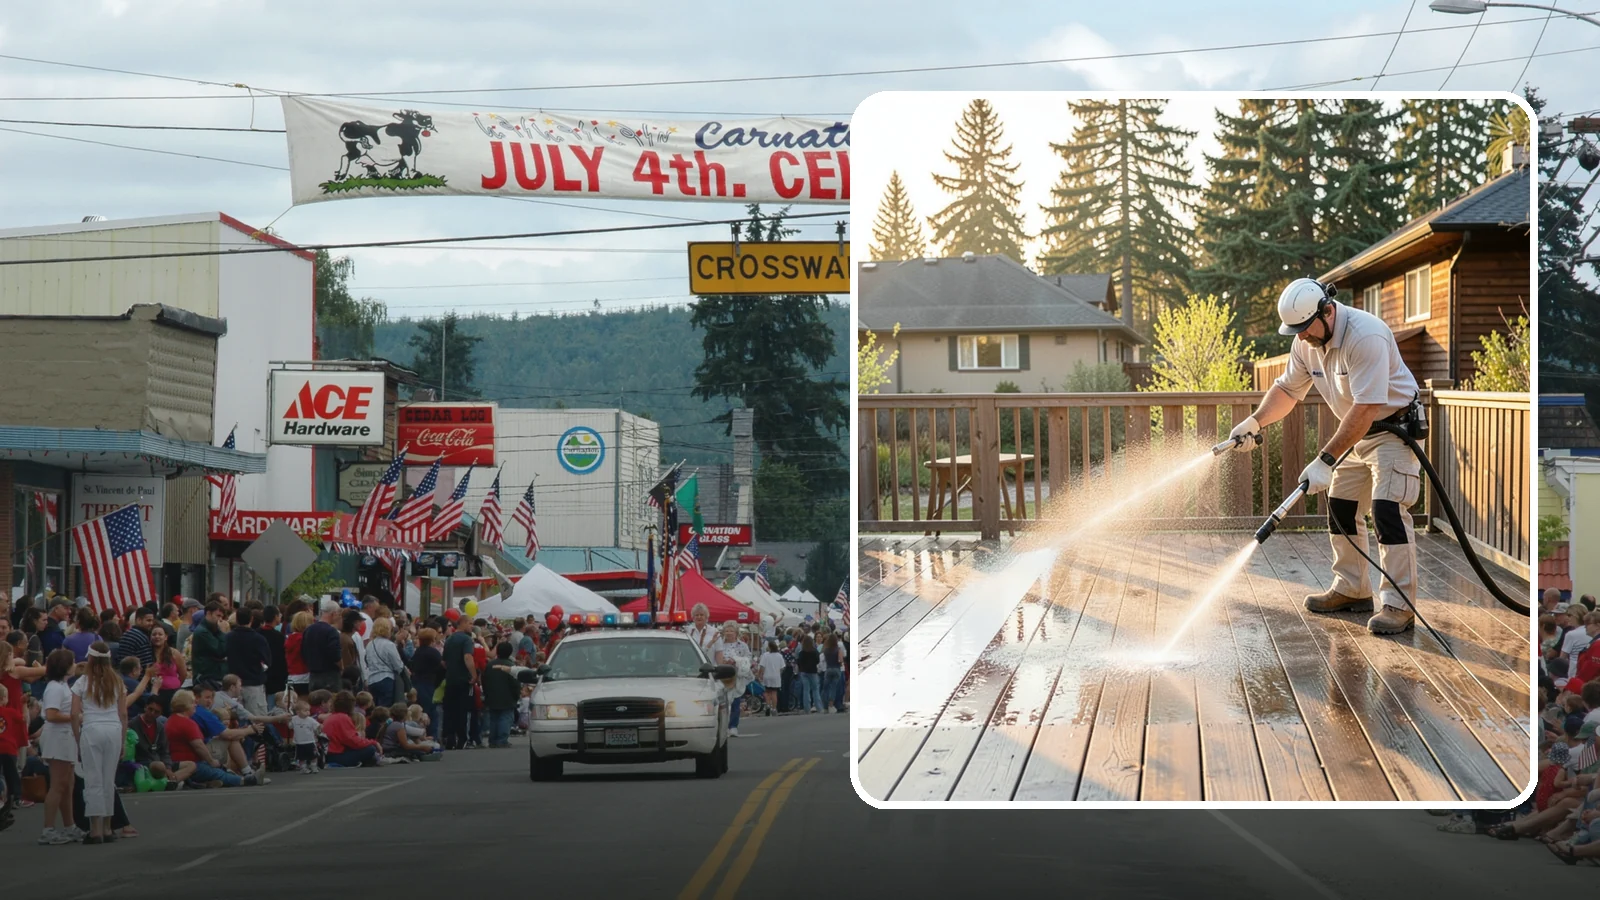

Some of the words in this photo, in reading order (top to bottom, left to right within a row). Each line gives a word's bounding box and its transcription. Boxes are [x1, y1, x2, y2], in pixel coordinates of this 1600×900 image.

[695, 121, 850, 150] Carnat
[481, 141, 604, 192] JULY
[632, 150, 746, 197] 4th.
[697, 254, 850, 281] CROSSWA
[282, 380, 373, 420] ACE
[406, 409, 452, 422] CEDAR
[462, 409, 485, 422] LOG
[283, 421, 371, 437] Hardware
[416, 428, 477, 447] Coca-Cola
[353, 467, 384, 478] Simpl
[95, 485, 124, 495] Vincent
[126, 486, 136, 495] de
[137, 486, 155, 495] Paul
[688, 526, 741, 535] CRNATION
[699, 535, 730, 543] GLASS
